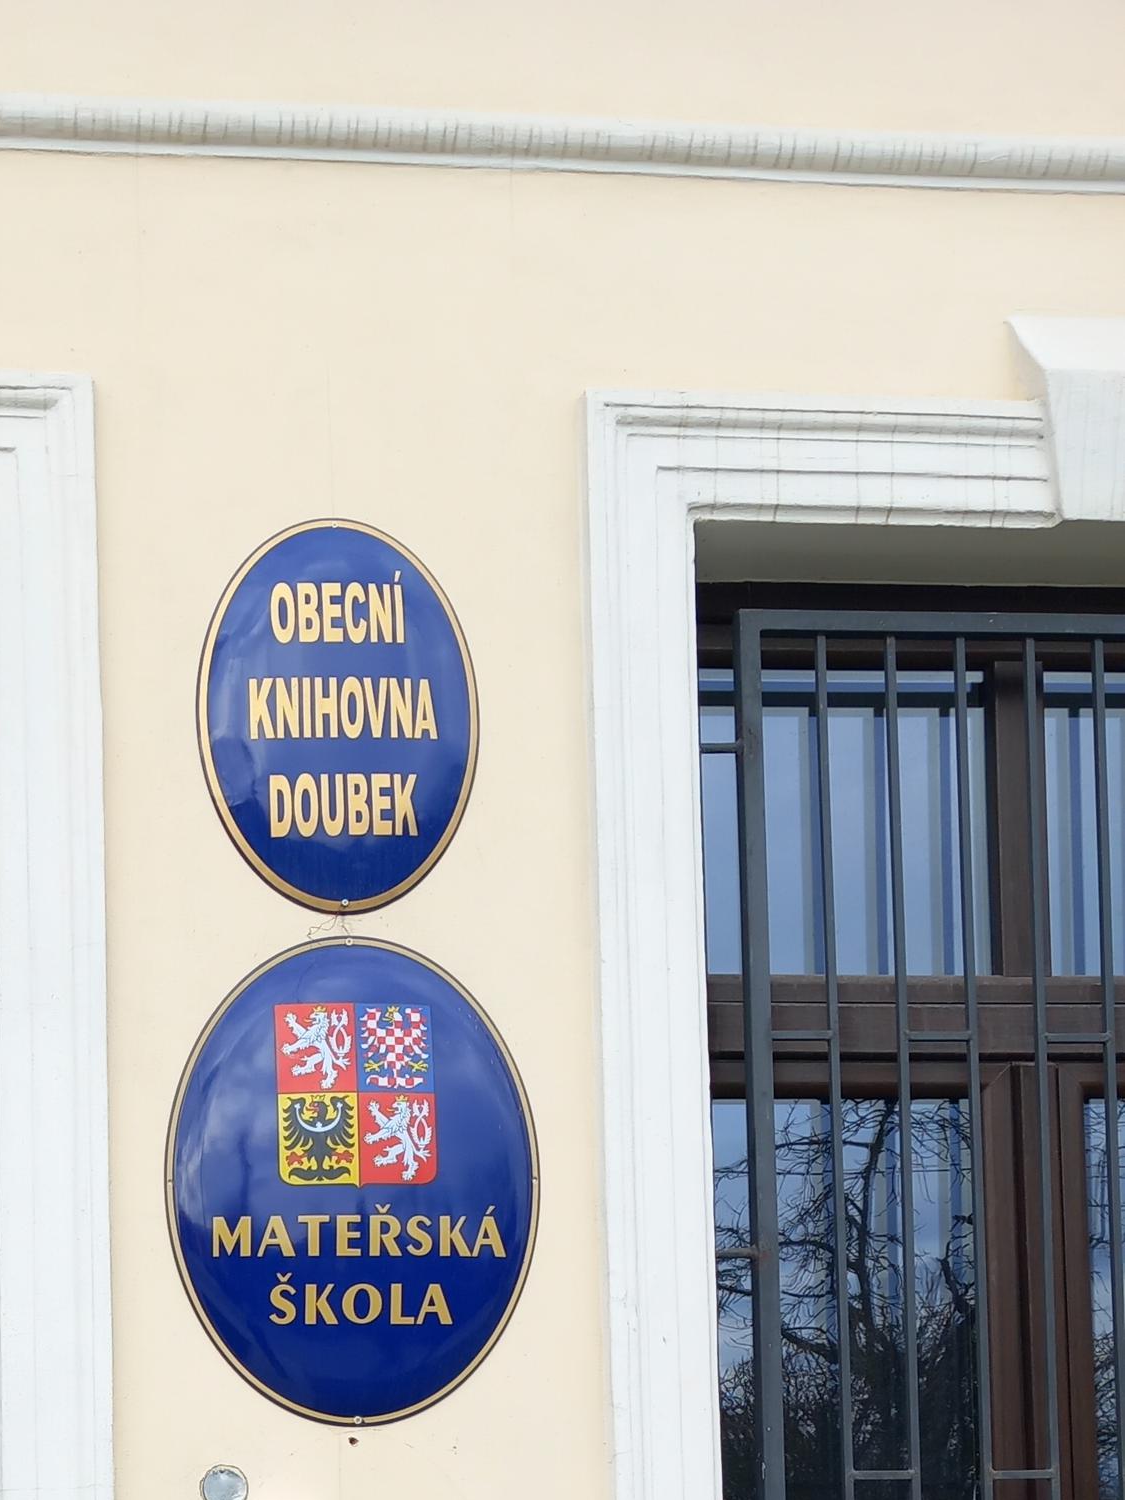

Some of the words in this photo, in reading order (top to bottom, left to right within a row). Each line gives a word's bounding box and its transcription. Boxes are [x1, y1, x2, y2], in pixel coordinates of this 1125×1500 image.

[270, 570, 405, 644] OBECNÍ
[248, 676, 438, 740] KNIHOVNA
[269, 773, 418, 838] DOUBEK
[211, 1203, 507, 1258] MATEŘSKÁ
[269, 1272, 453, 1326] ŠKOLA
